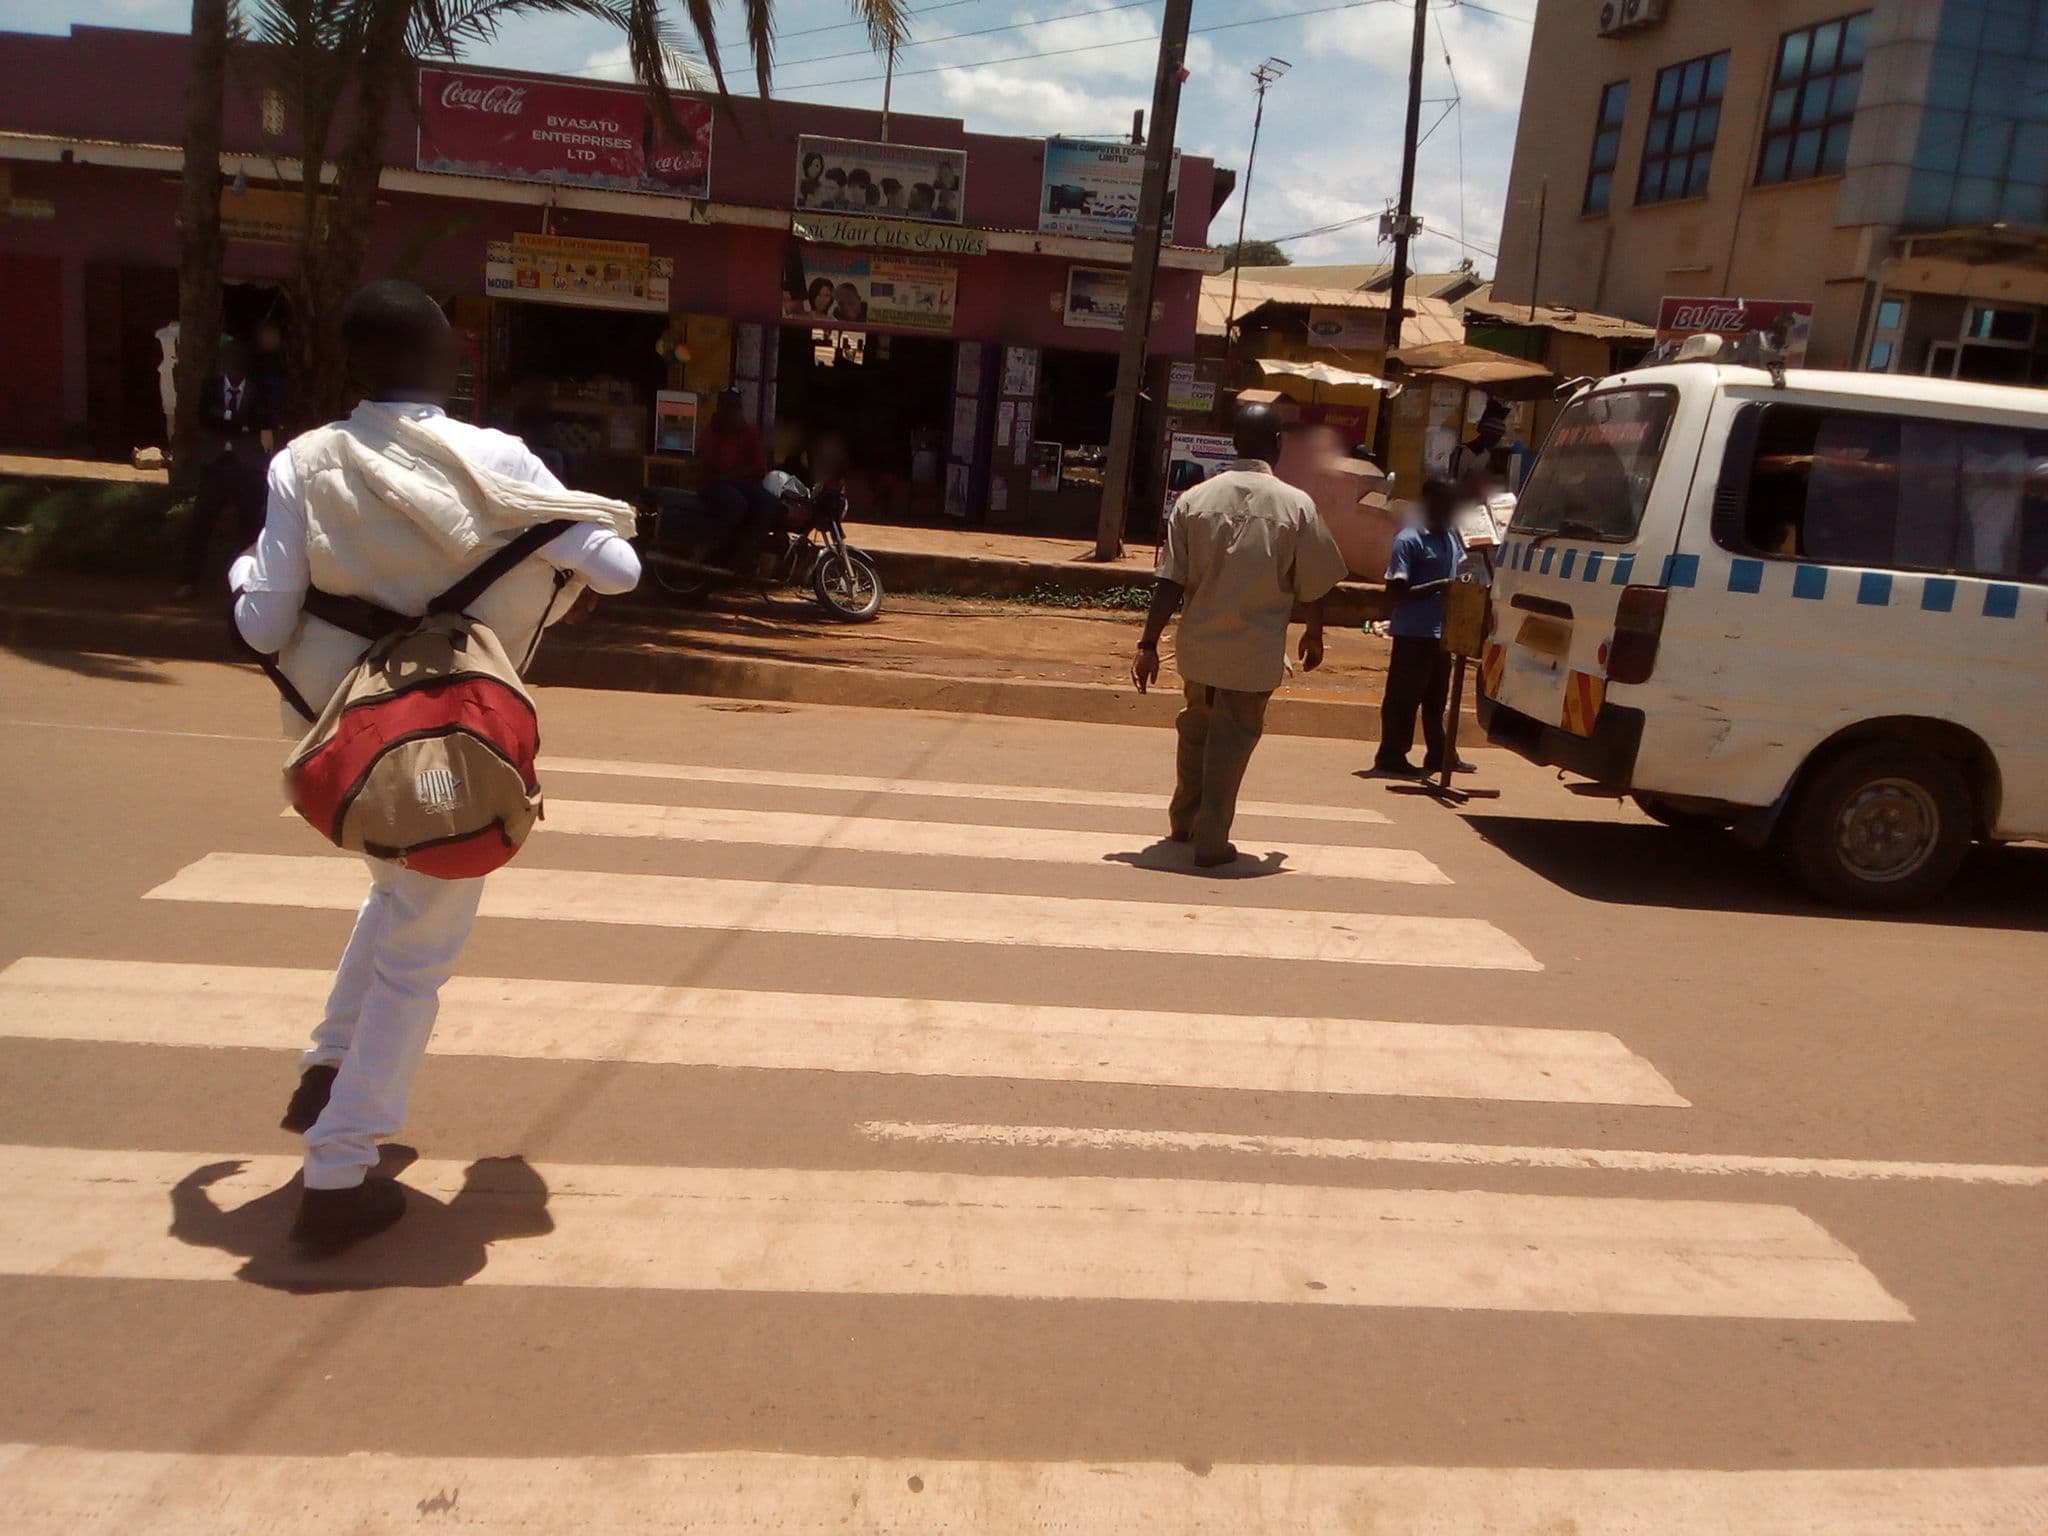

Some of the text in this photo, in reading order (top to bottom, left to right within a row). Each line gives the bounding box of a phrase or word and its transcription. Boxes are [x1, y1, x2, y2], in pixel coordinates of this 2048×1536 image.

[547, 115, 619, 133] BYASATU
[532, 129, 633, 150] ENTERPRISES
[567, 148, 597, 161] LTD
[832, 222, 869, 241] Hair
[872, 224, 911, 246] Cuts
[936, 231, 984, 253] Styles
[1671, 305, 1748, 331] BLITZ
[1170, 372, 1193, 382] COPY
[1191, 392, 1216, 401] COPY
